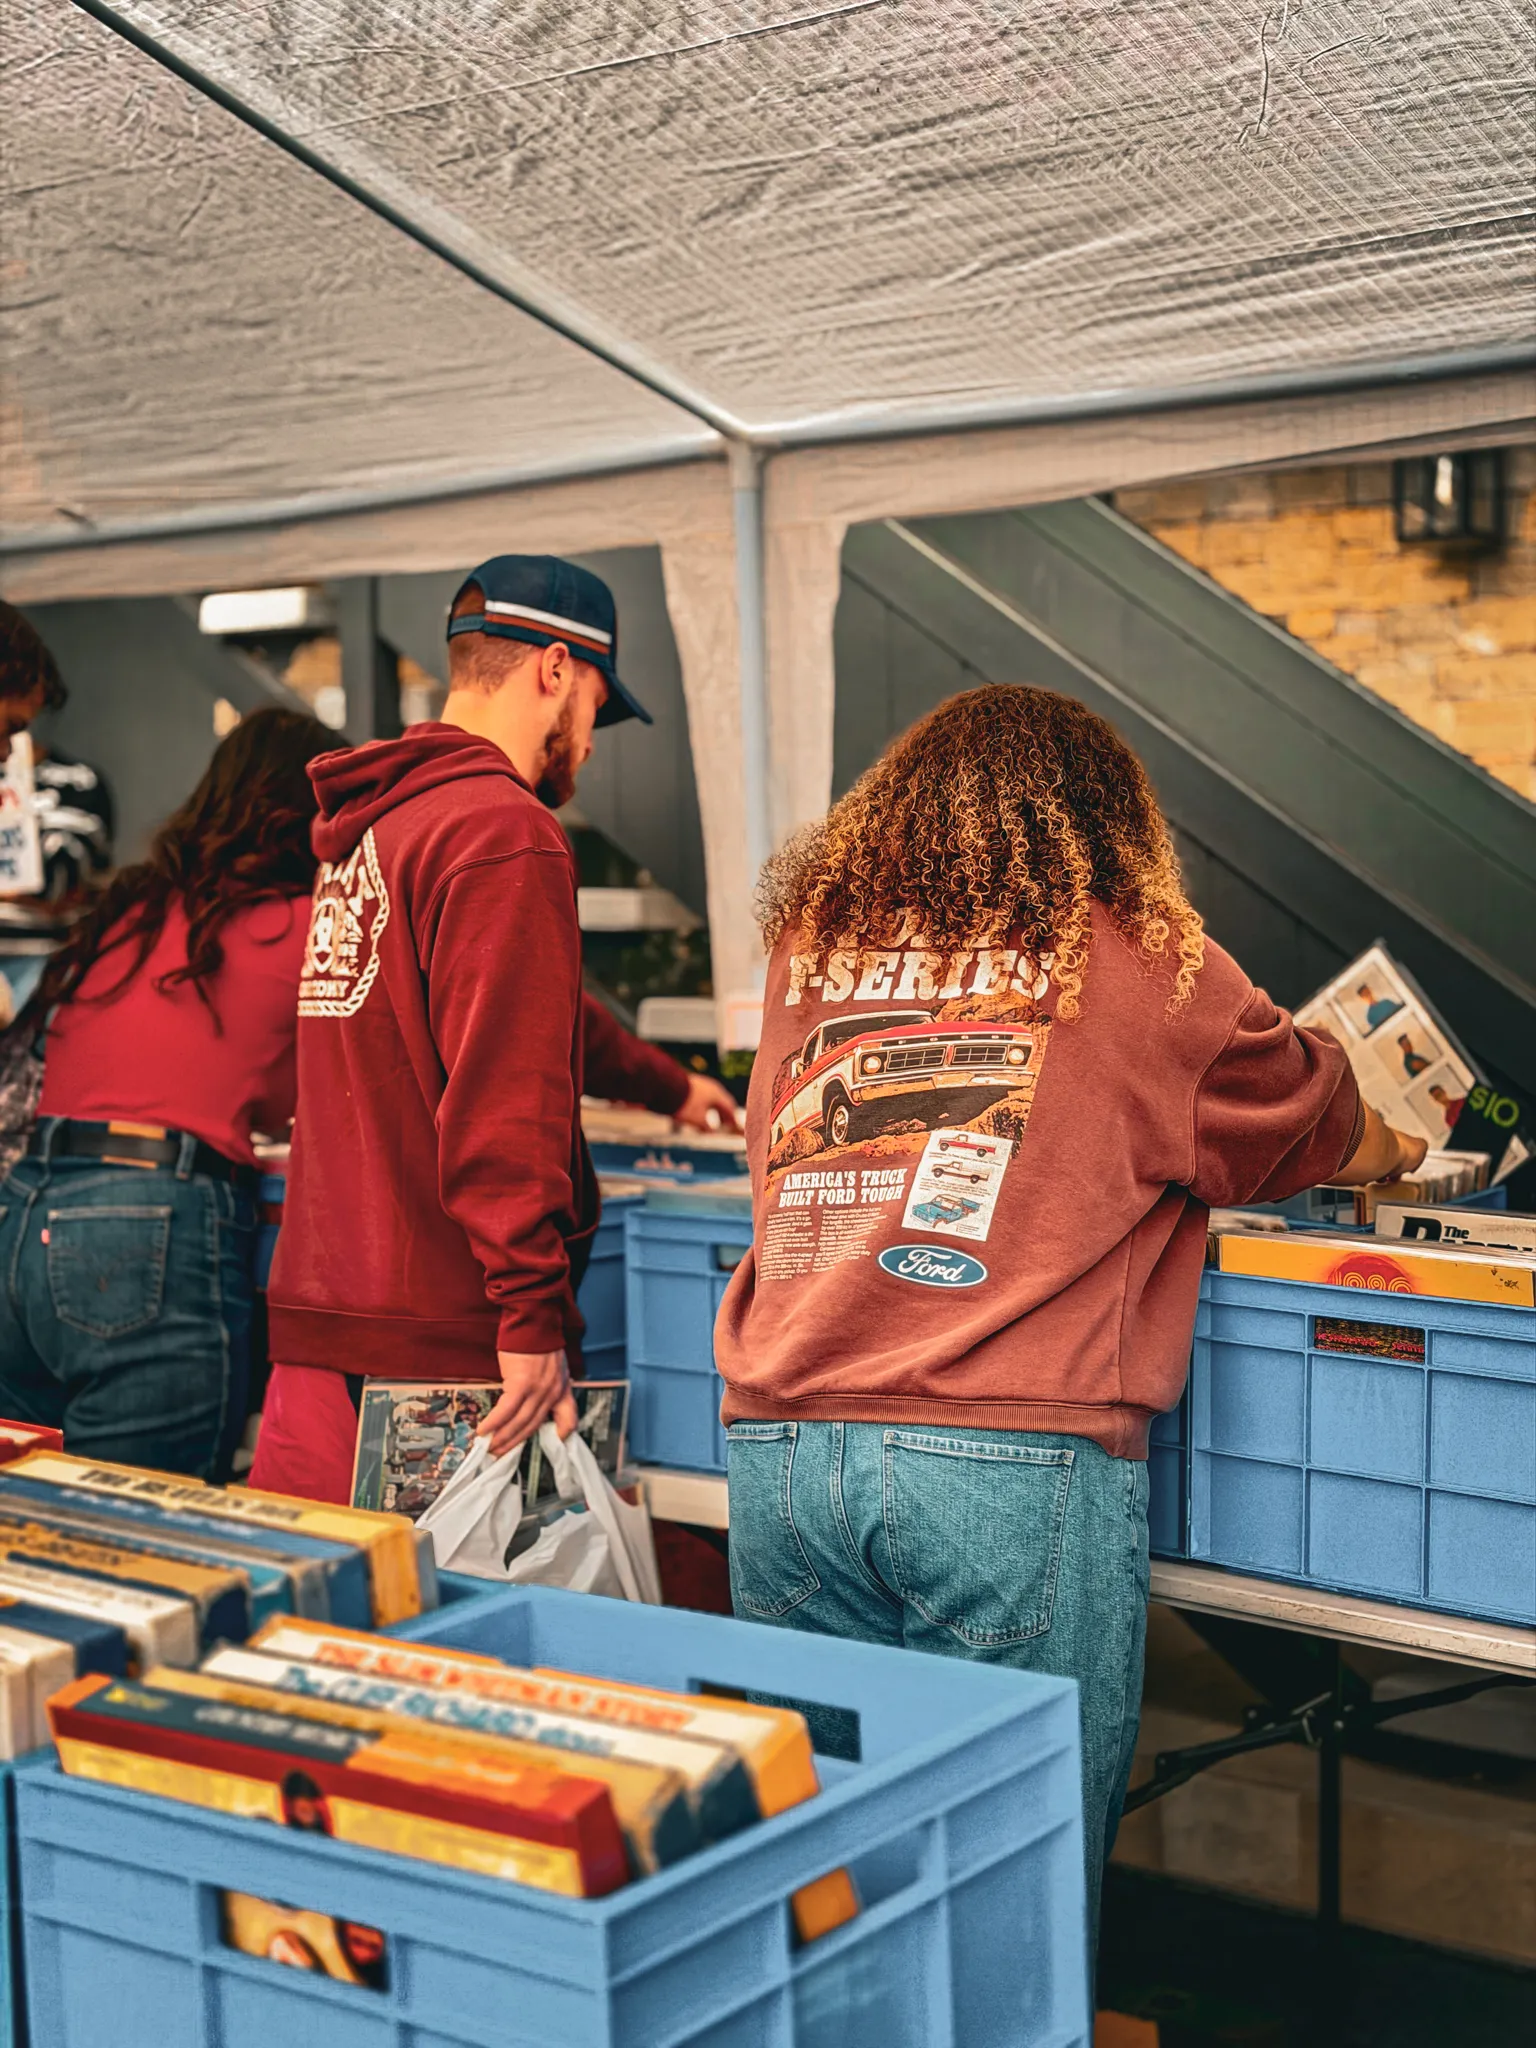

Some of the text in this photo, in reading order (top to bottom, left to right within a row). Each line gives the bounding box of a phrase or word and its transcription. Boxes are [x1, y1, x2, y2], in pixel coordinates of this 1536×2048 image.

[785, 949, 1055, 1006] F-SERIES
[783, 1168, 908, 1190] AMERICA'S TRUCK
[778, 1190, 815, 1208] BUILT
[816, 1188, 856, 1206] FORD
[860, 1184, 904, 1202] TOUGH
[1444, 1225, 1470, 1239] The
[898, 1248, 966, 1282] Ford
